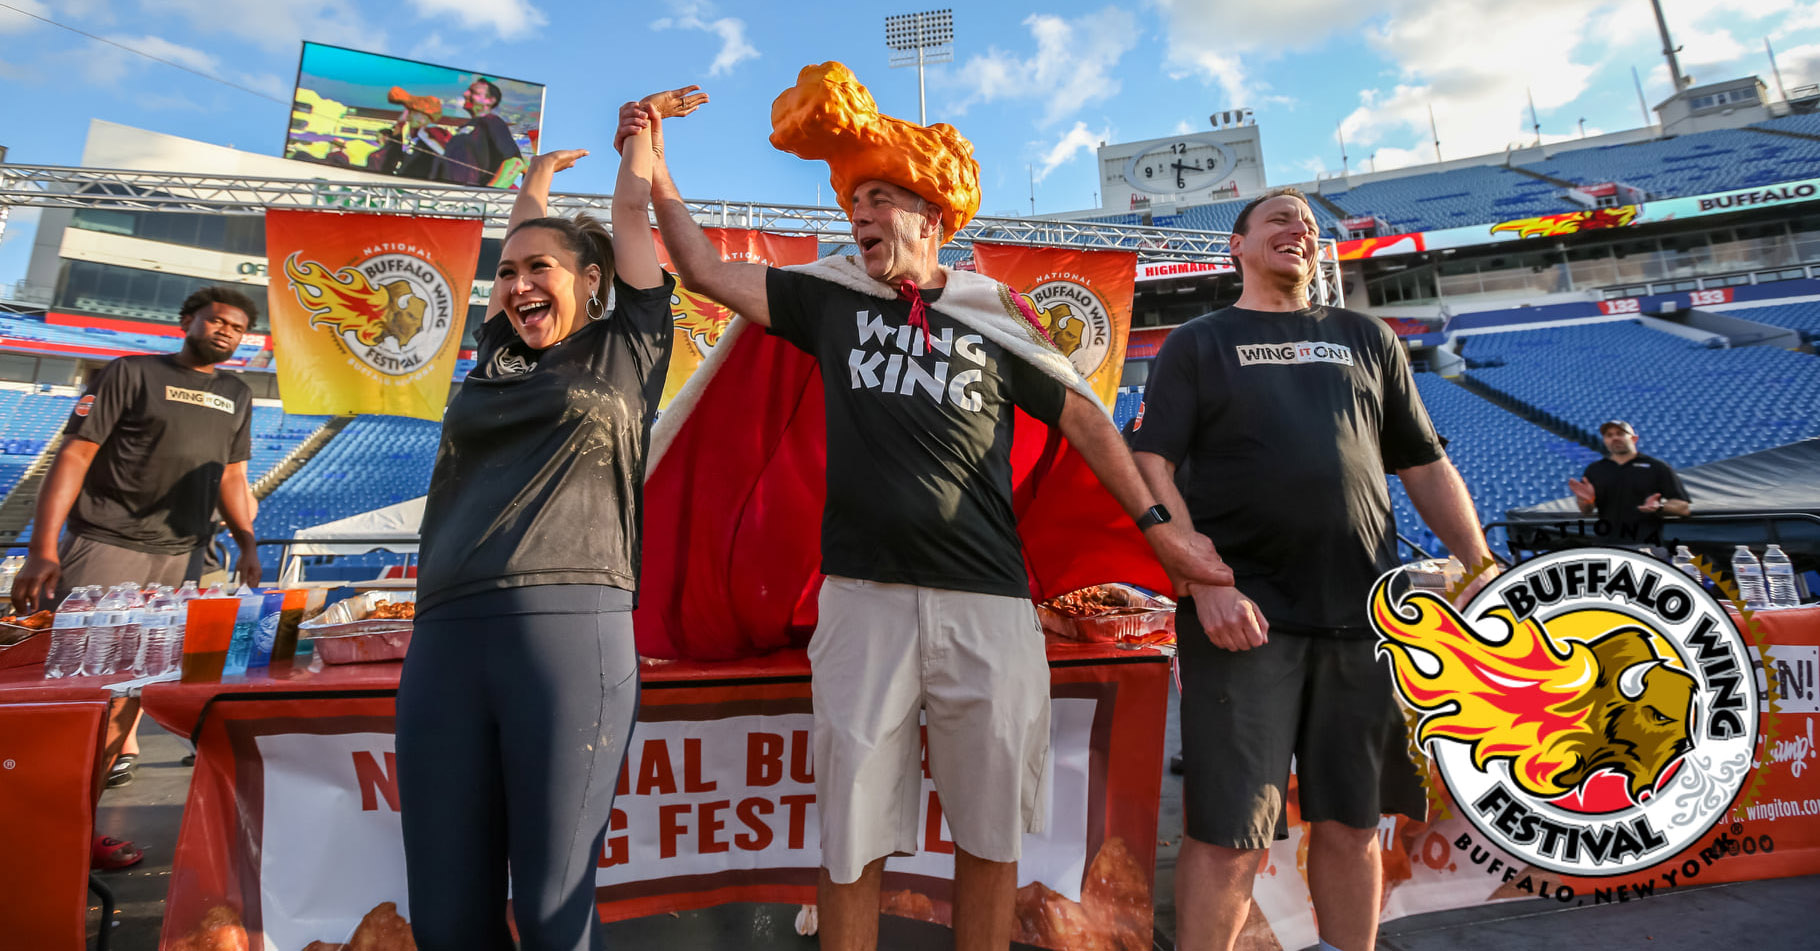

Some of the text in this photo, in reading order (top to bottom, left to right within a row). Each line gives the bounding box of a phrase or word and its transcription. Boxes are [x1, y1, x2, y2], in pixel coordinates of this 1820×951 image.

[1170, 143, 1186, 155] 12
[1206, 158, 1215, 170] 3
[1145, 167, 1153, 178] 9
[1700, 183, 1816, 212] BUFFALO
[363, 243, 431, 259] NATIONAL
[1145, 262, 1216, 277] HIGHMARK
[1035, 272, 1091, 286] NATIONAL
[365, 259, 448, 328] BUFFALO WING
[1689, 290, 1725, 306] 133
[1034, 285, 1105, 345] BUFFALO WING
[1605, 299, 1640, 315] 132
[856, 310, 986, 367] WING
[1241, 346, 1349, 361] WING IT ON!
[848, 348, 983, 412] KING
[169, 389, 203, 402] WING
[1747, 798, 1820, 821] wingiton.co
